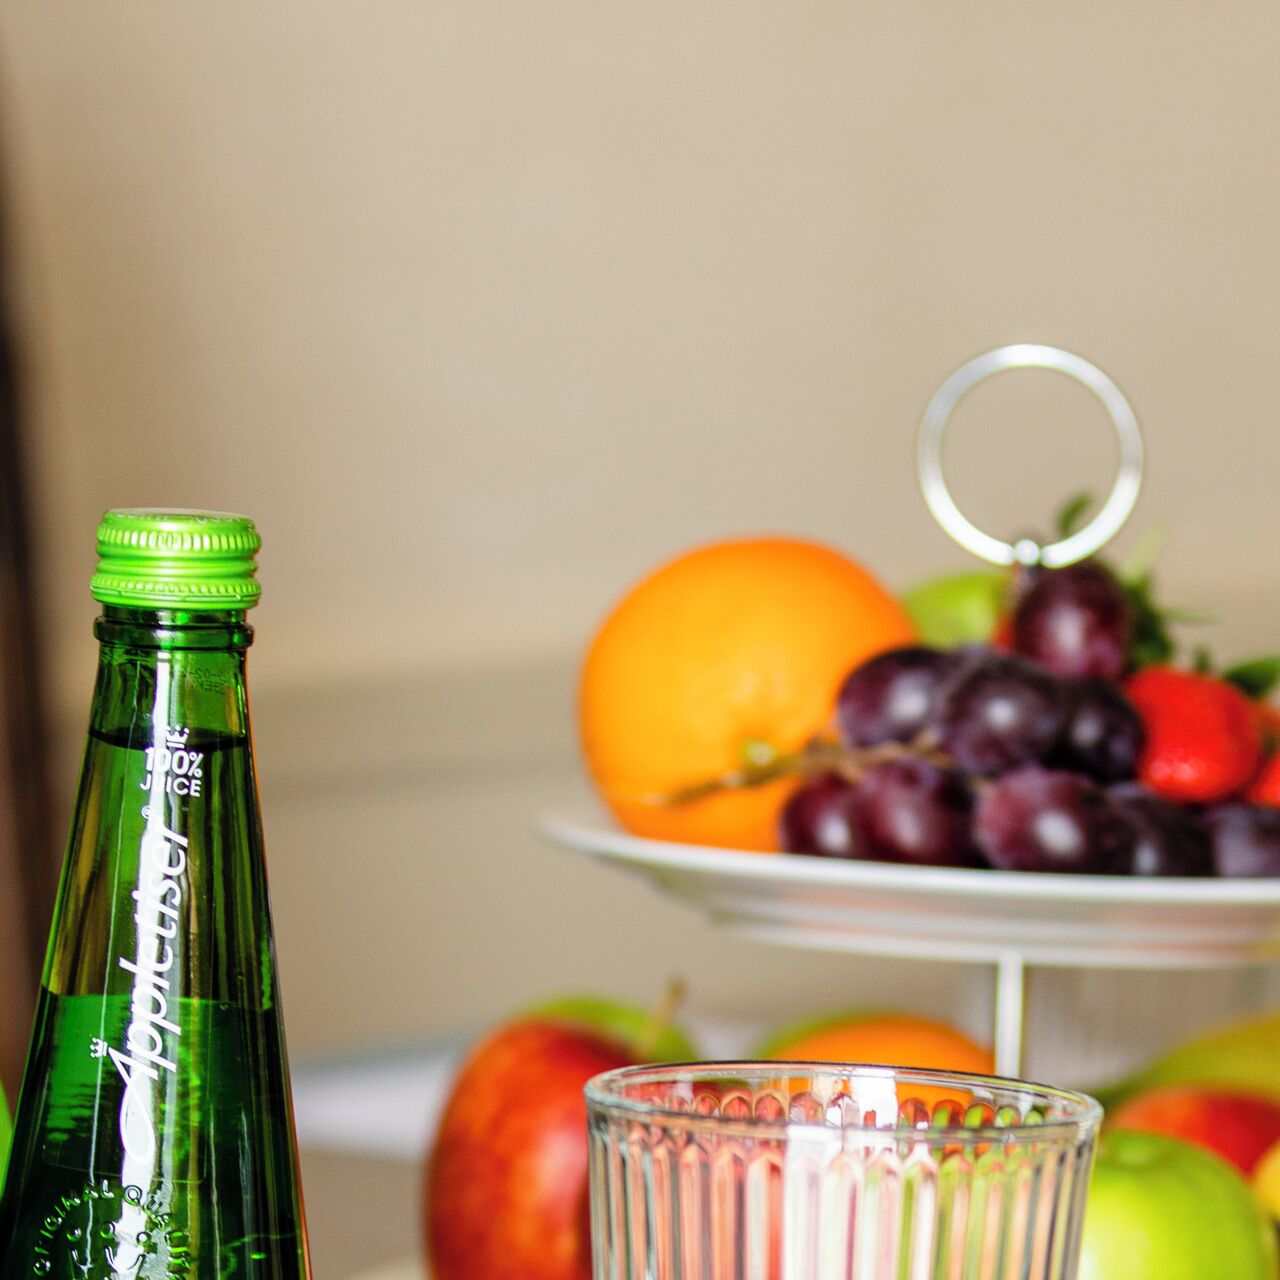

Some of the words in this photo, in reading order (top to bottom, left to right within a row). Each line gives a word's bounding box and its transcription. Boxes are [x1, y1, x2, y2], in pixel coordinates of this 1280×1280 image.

[145, 747, 204, 778] 100%
[140, 773, 201, 797] JICE
[108, 813, 189, 1166] Appletiser
